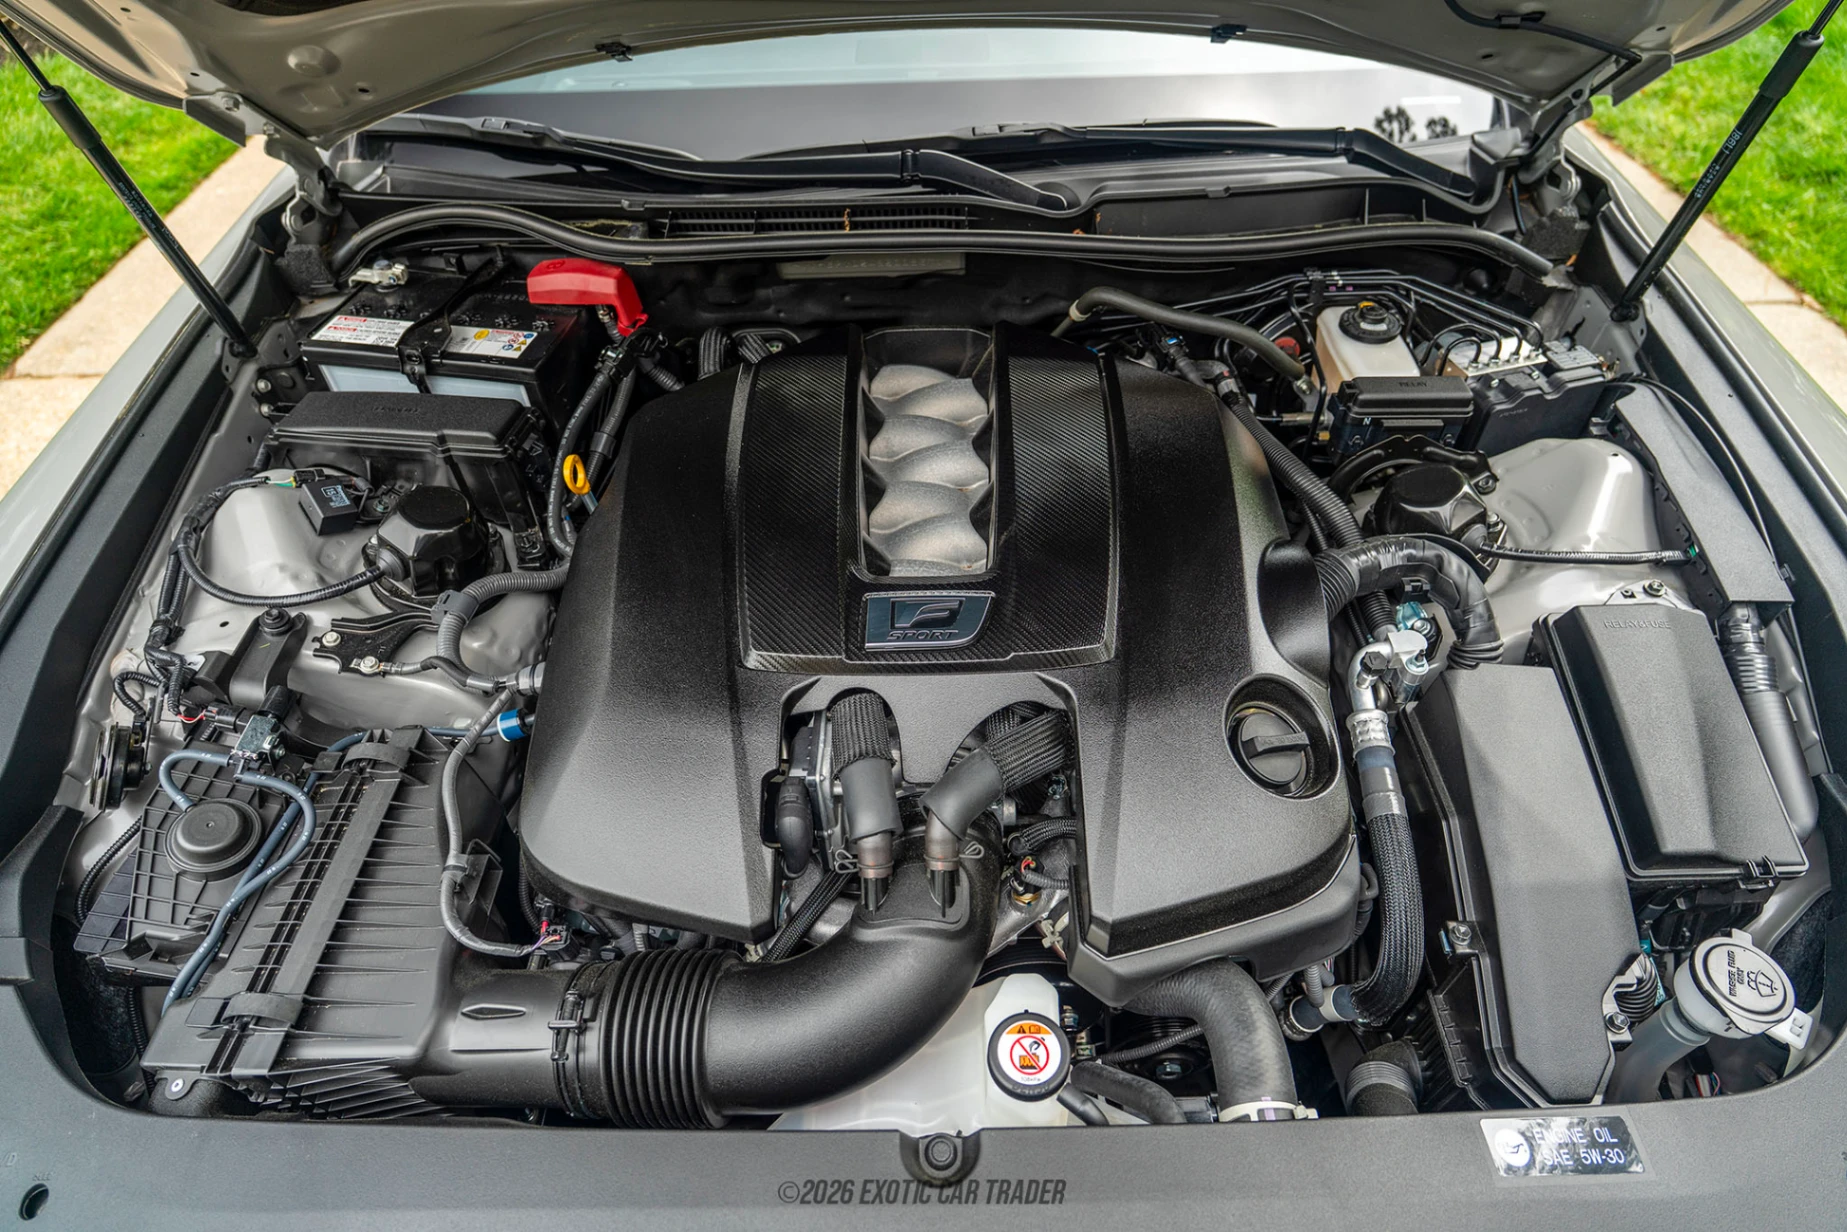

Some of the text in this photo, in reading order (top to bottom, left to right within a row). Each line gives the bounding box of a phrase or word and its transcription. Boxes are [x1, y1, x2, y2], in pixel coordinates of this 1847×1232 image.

[886, 629, 959, 641] SPORT
[1532, 1127, 1618, 1144] ENGINE OIL
[1540, 1148, 1626, 1166] SAE 5W-30
